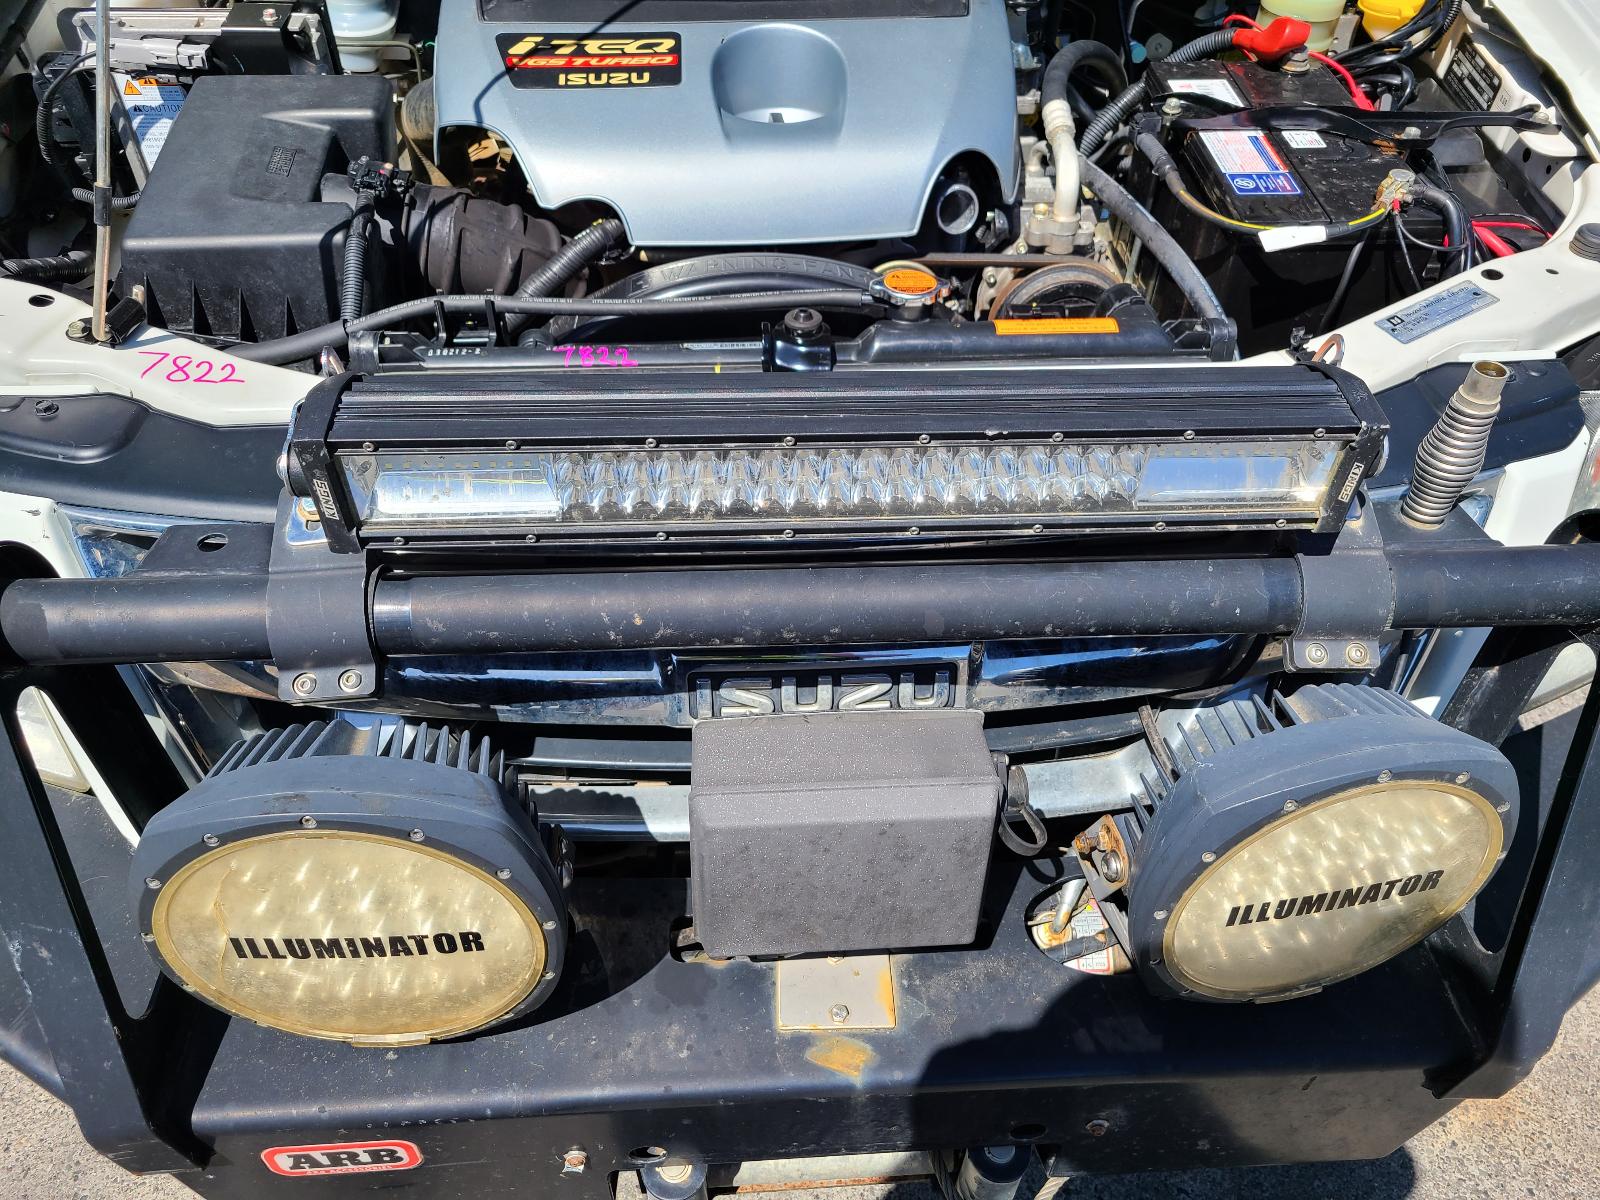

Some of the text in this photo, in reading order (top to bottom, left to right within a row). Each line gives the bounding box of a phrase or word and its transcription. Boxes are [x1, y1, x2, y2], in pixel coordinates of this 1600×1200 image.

[512, 56, 672, 66] VGS TURBO
[558, 72, 650, 86] ISUZU
[142, 104, 183, 113] CAUTION
[138, 350, 246, 384] 7822
[553, 345, 639, 368] 7822
[1340, 463, 1363, 502] KINGS
[315, 479, 339, 520] KINGS
[695, 671, 950, 719] ISUZU
[1225, 869, 1445, 928] ILLUMINATOR
[229, 931, 486, 960] ILLUMINATOR
[286, 1148, 404, 1171] ARB
